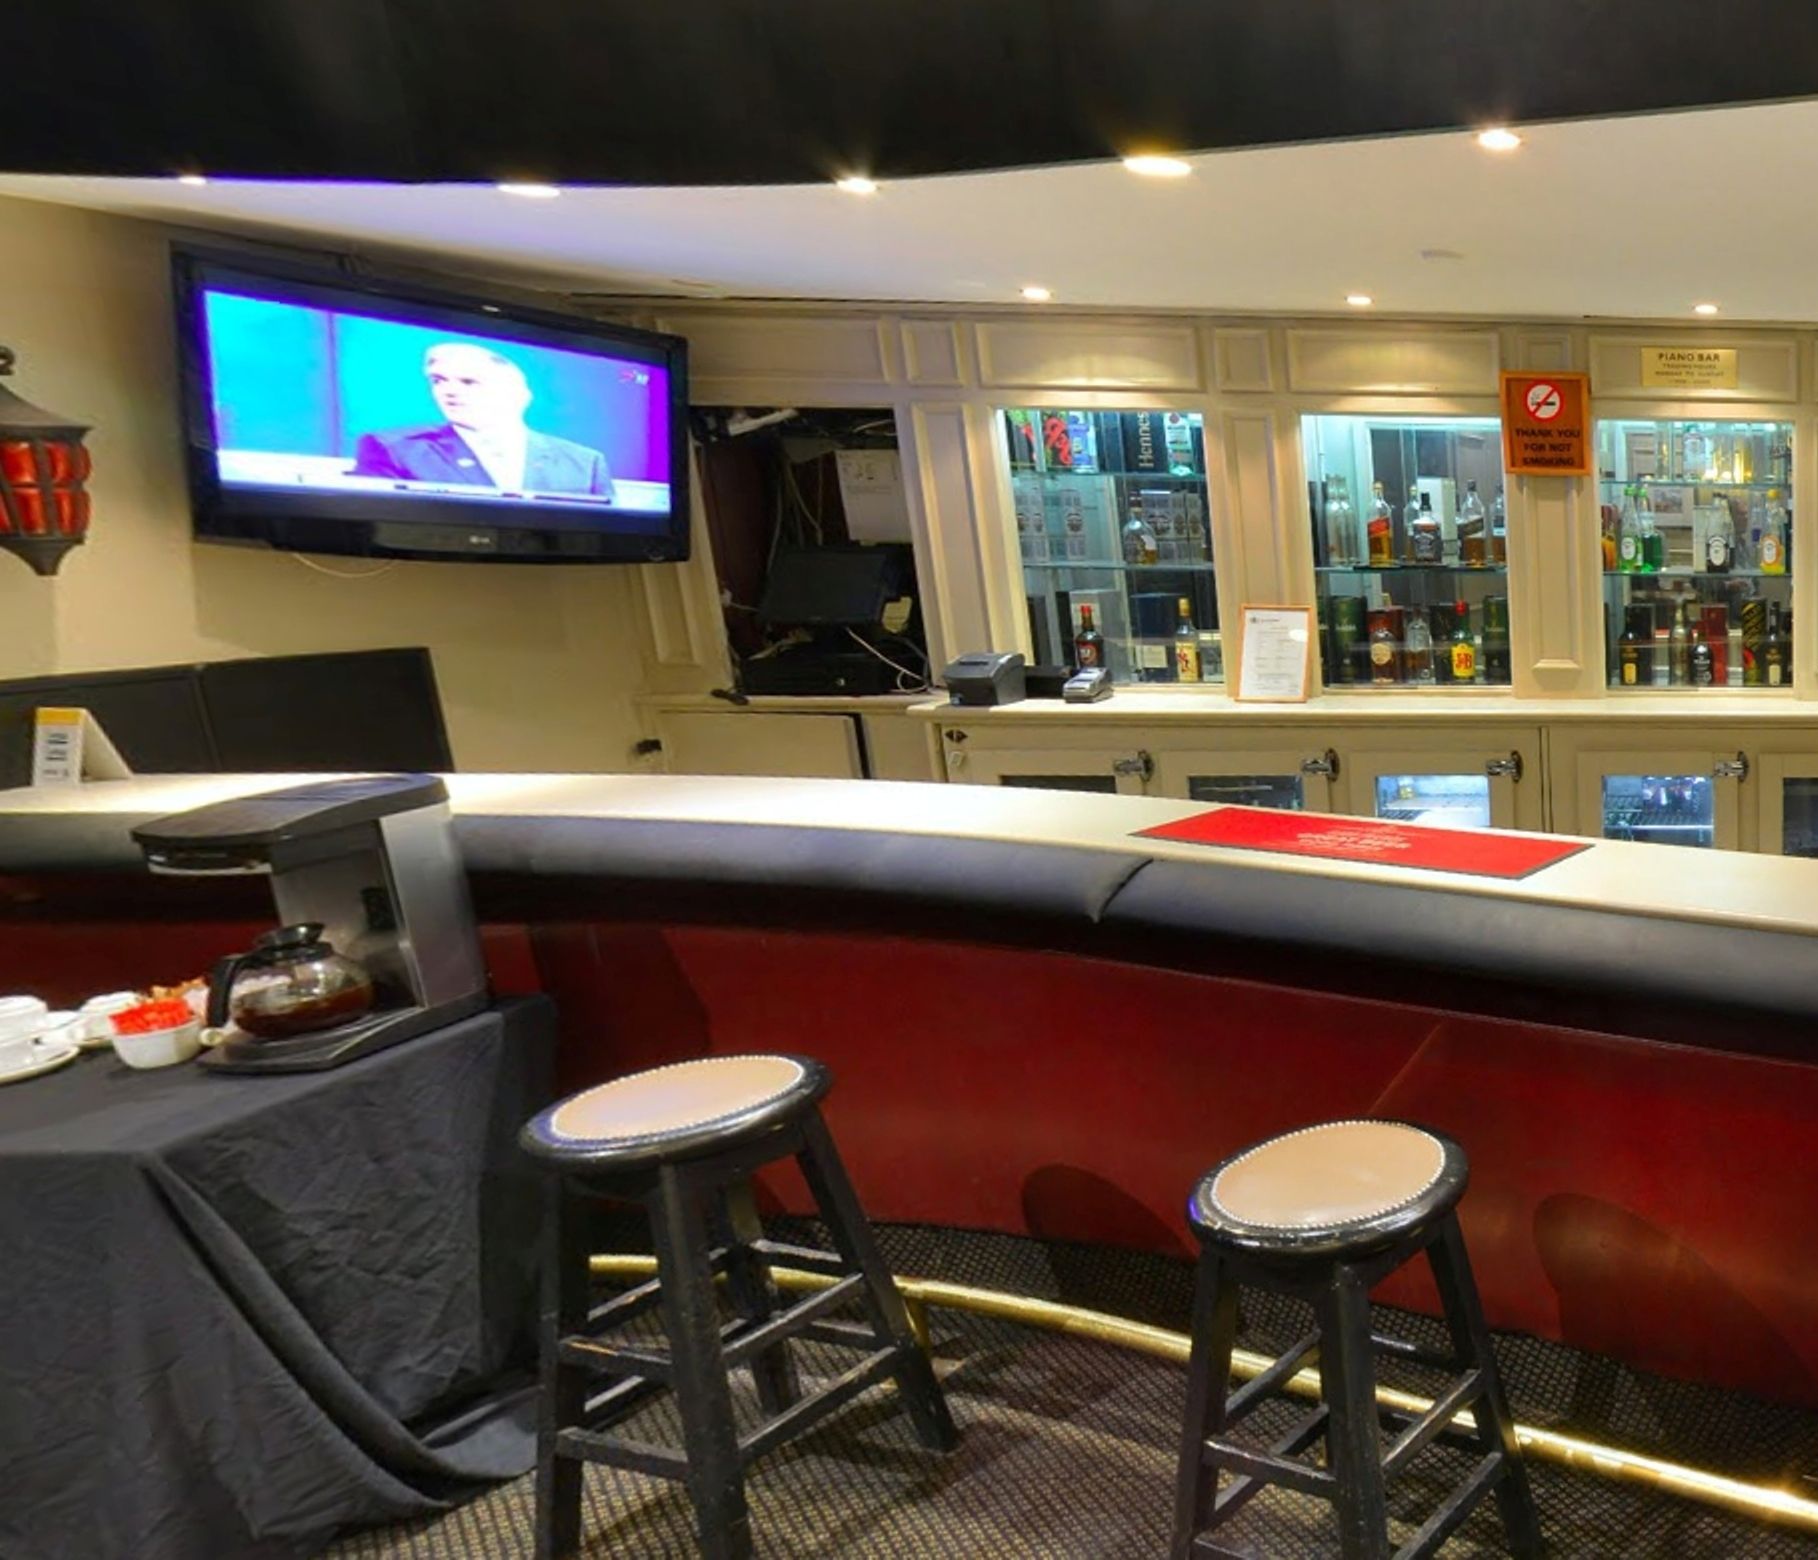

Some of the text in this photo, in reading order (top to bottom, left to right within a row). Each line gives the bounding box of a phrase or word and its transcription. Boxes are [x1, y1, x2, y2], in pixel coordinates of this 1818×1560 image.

[1658, 352, 1720, 362] PIANO BAR
[1515, 428, 1580, 438] THANK YOU
[1524, 443, 1572, 452] FOR NOT
[1523, 457, 1575, 466] SMOKING
